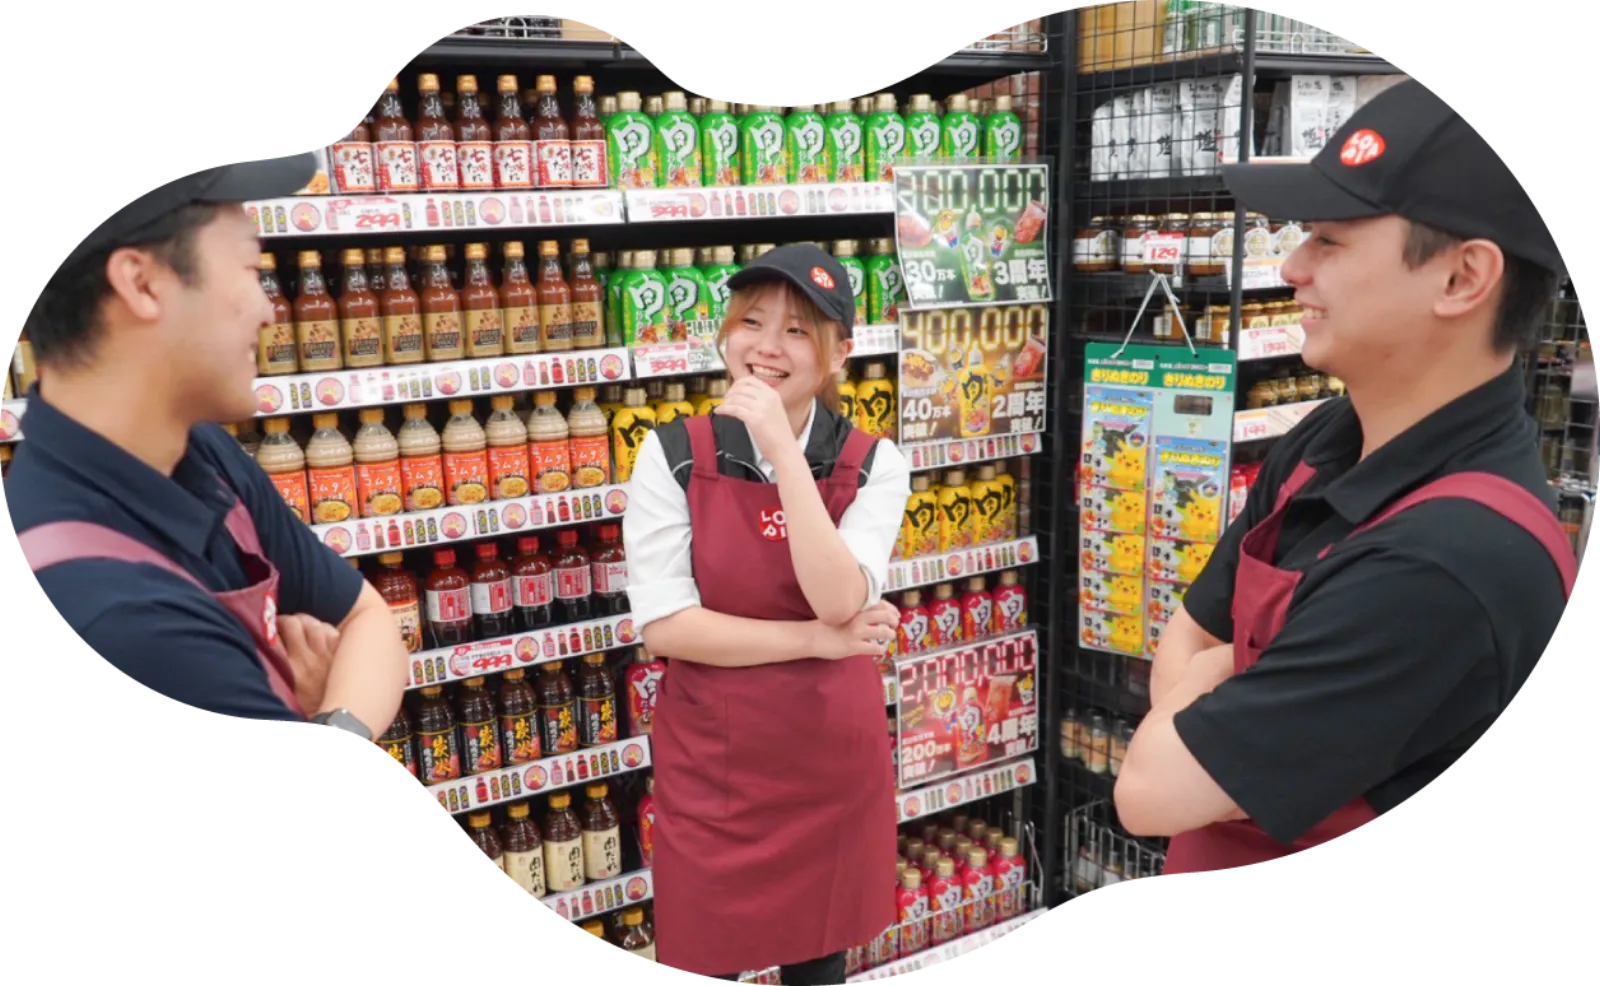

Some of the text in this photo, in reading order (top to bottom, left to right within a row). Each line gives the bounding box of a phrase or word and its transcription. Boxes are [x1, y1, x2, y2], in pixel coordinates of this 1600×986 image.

[355, 213, 400, 228] 299
[1150, 247, 1178, 260] 129
[761, 510, 787, 526] LO
[472, 654, 512, 670] 999
